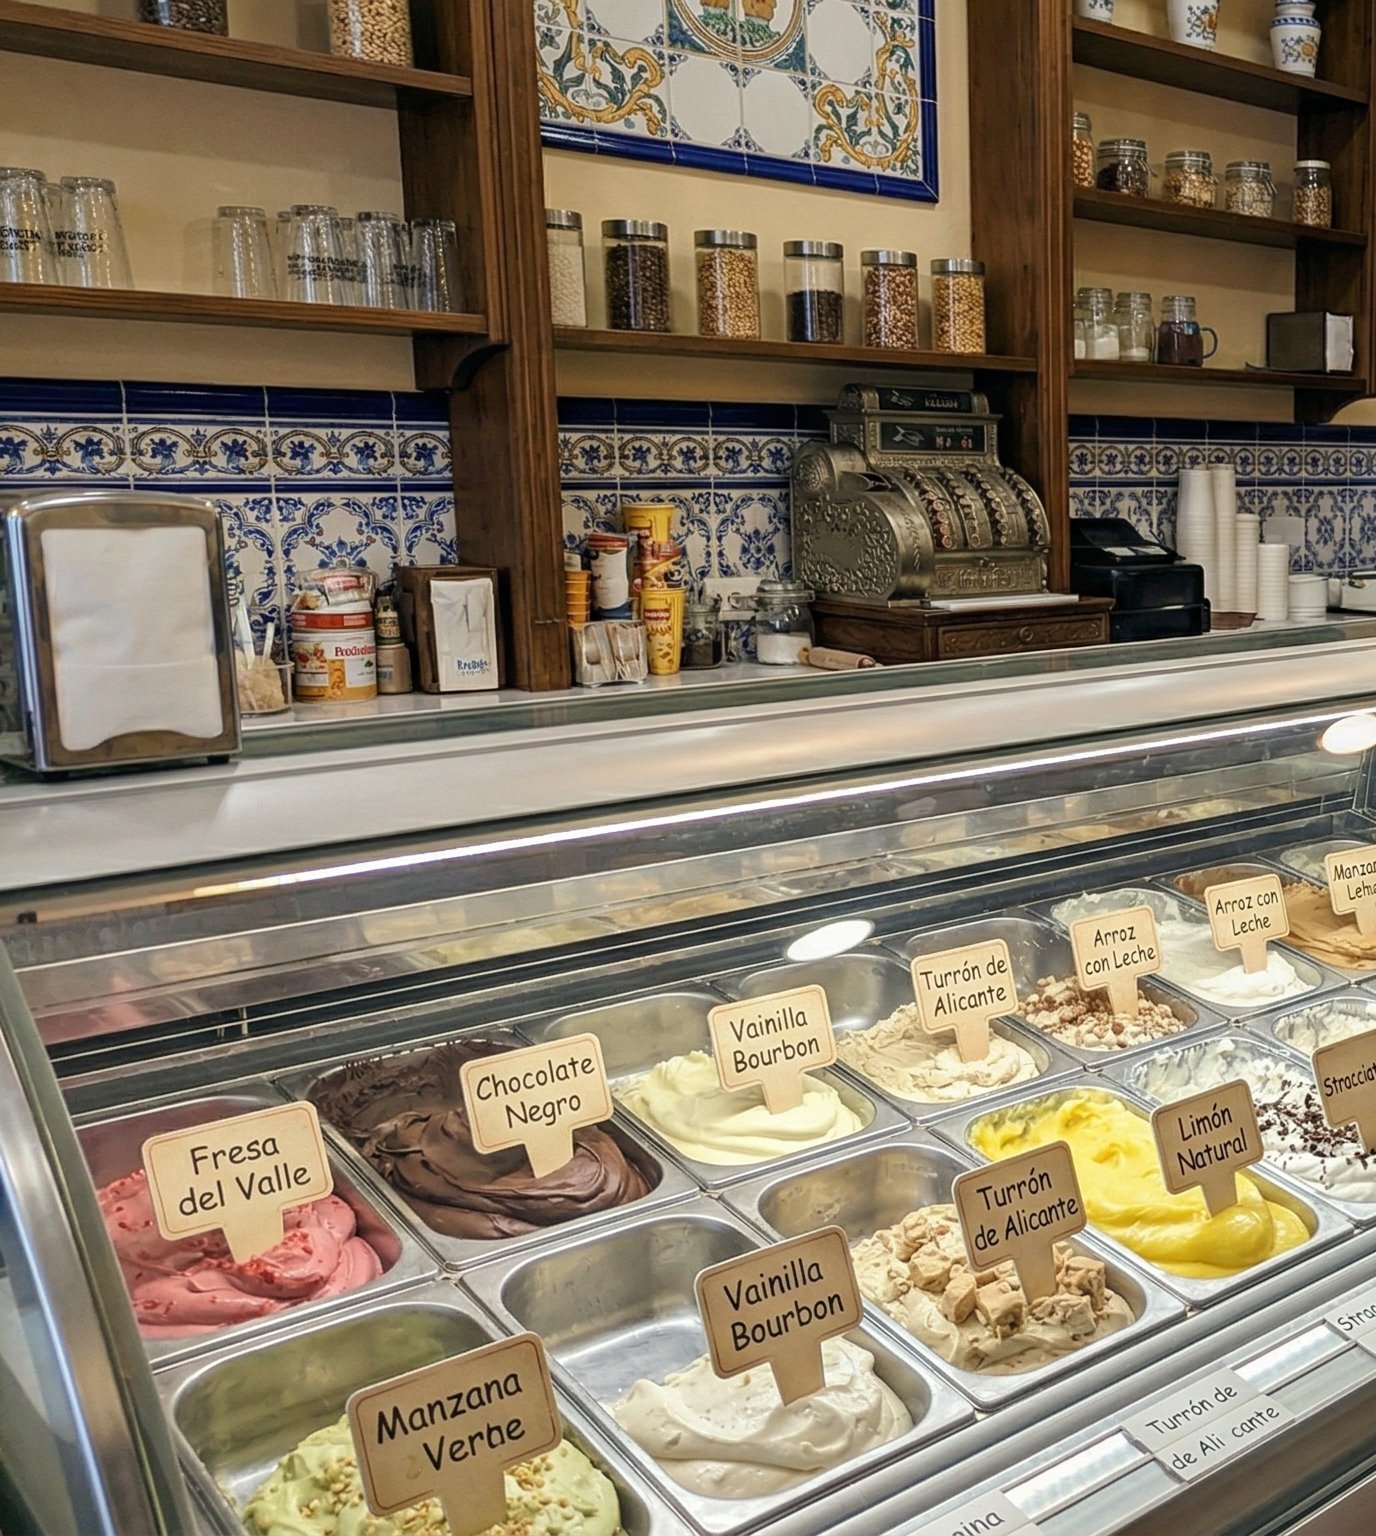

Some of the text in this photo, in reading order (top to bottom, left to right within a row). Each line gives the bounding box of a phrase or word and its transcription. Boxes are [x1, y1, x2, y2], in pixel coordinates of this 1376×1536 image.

[1215, 890, 1279, 916] Arroz con
[1093, 924, 1137, 948] Arroz
[1231, 913, 1272, 937] Leche
[920, 956, 1009, 991] Turrón de
[1085, 945, 1157, 975] con Leche
[933, 984, 1008, 1018] Alicante
[729, 1006, 809, 1043] Vainilla
[733, 1034, 821, 1074] Bourbon
[475, 1056, 596, 1101] Chocolate
[505, 1091, 582, 1129] Negro
[1177, 1102, 1233, 1143] Limón
[189, 1136, 281, 1175] Fresa
[1176, 1129, 1249, 1176] Natural
[178, 1163, 312, 1218] del Valle
[976, 1167, 1053, 1212] Turrón
[974, 1195, 1079, 1252] de Alicante
[723, 1258, 824, 1311] Vainilla
[730, 1291, 845, 1352] Bourbon
[377, 1373, 523, 1444] Manzana
[1145, 1384, 1238, 1436] Turrón de
[1171, 1450, 1197, 1471] de
